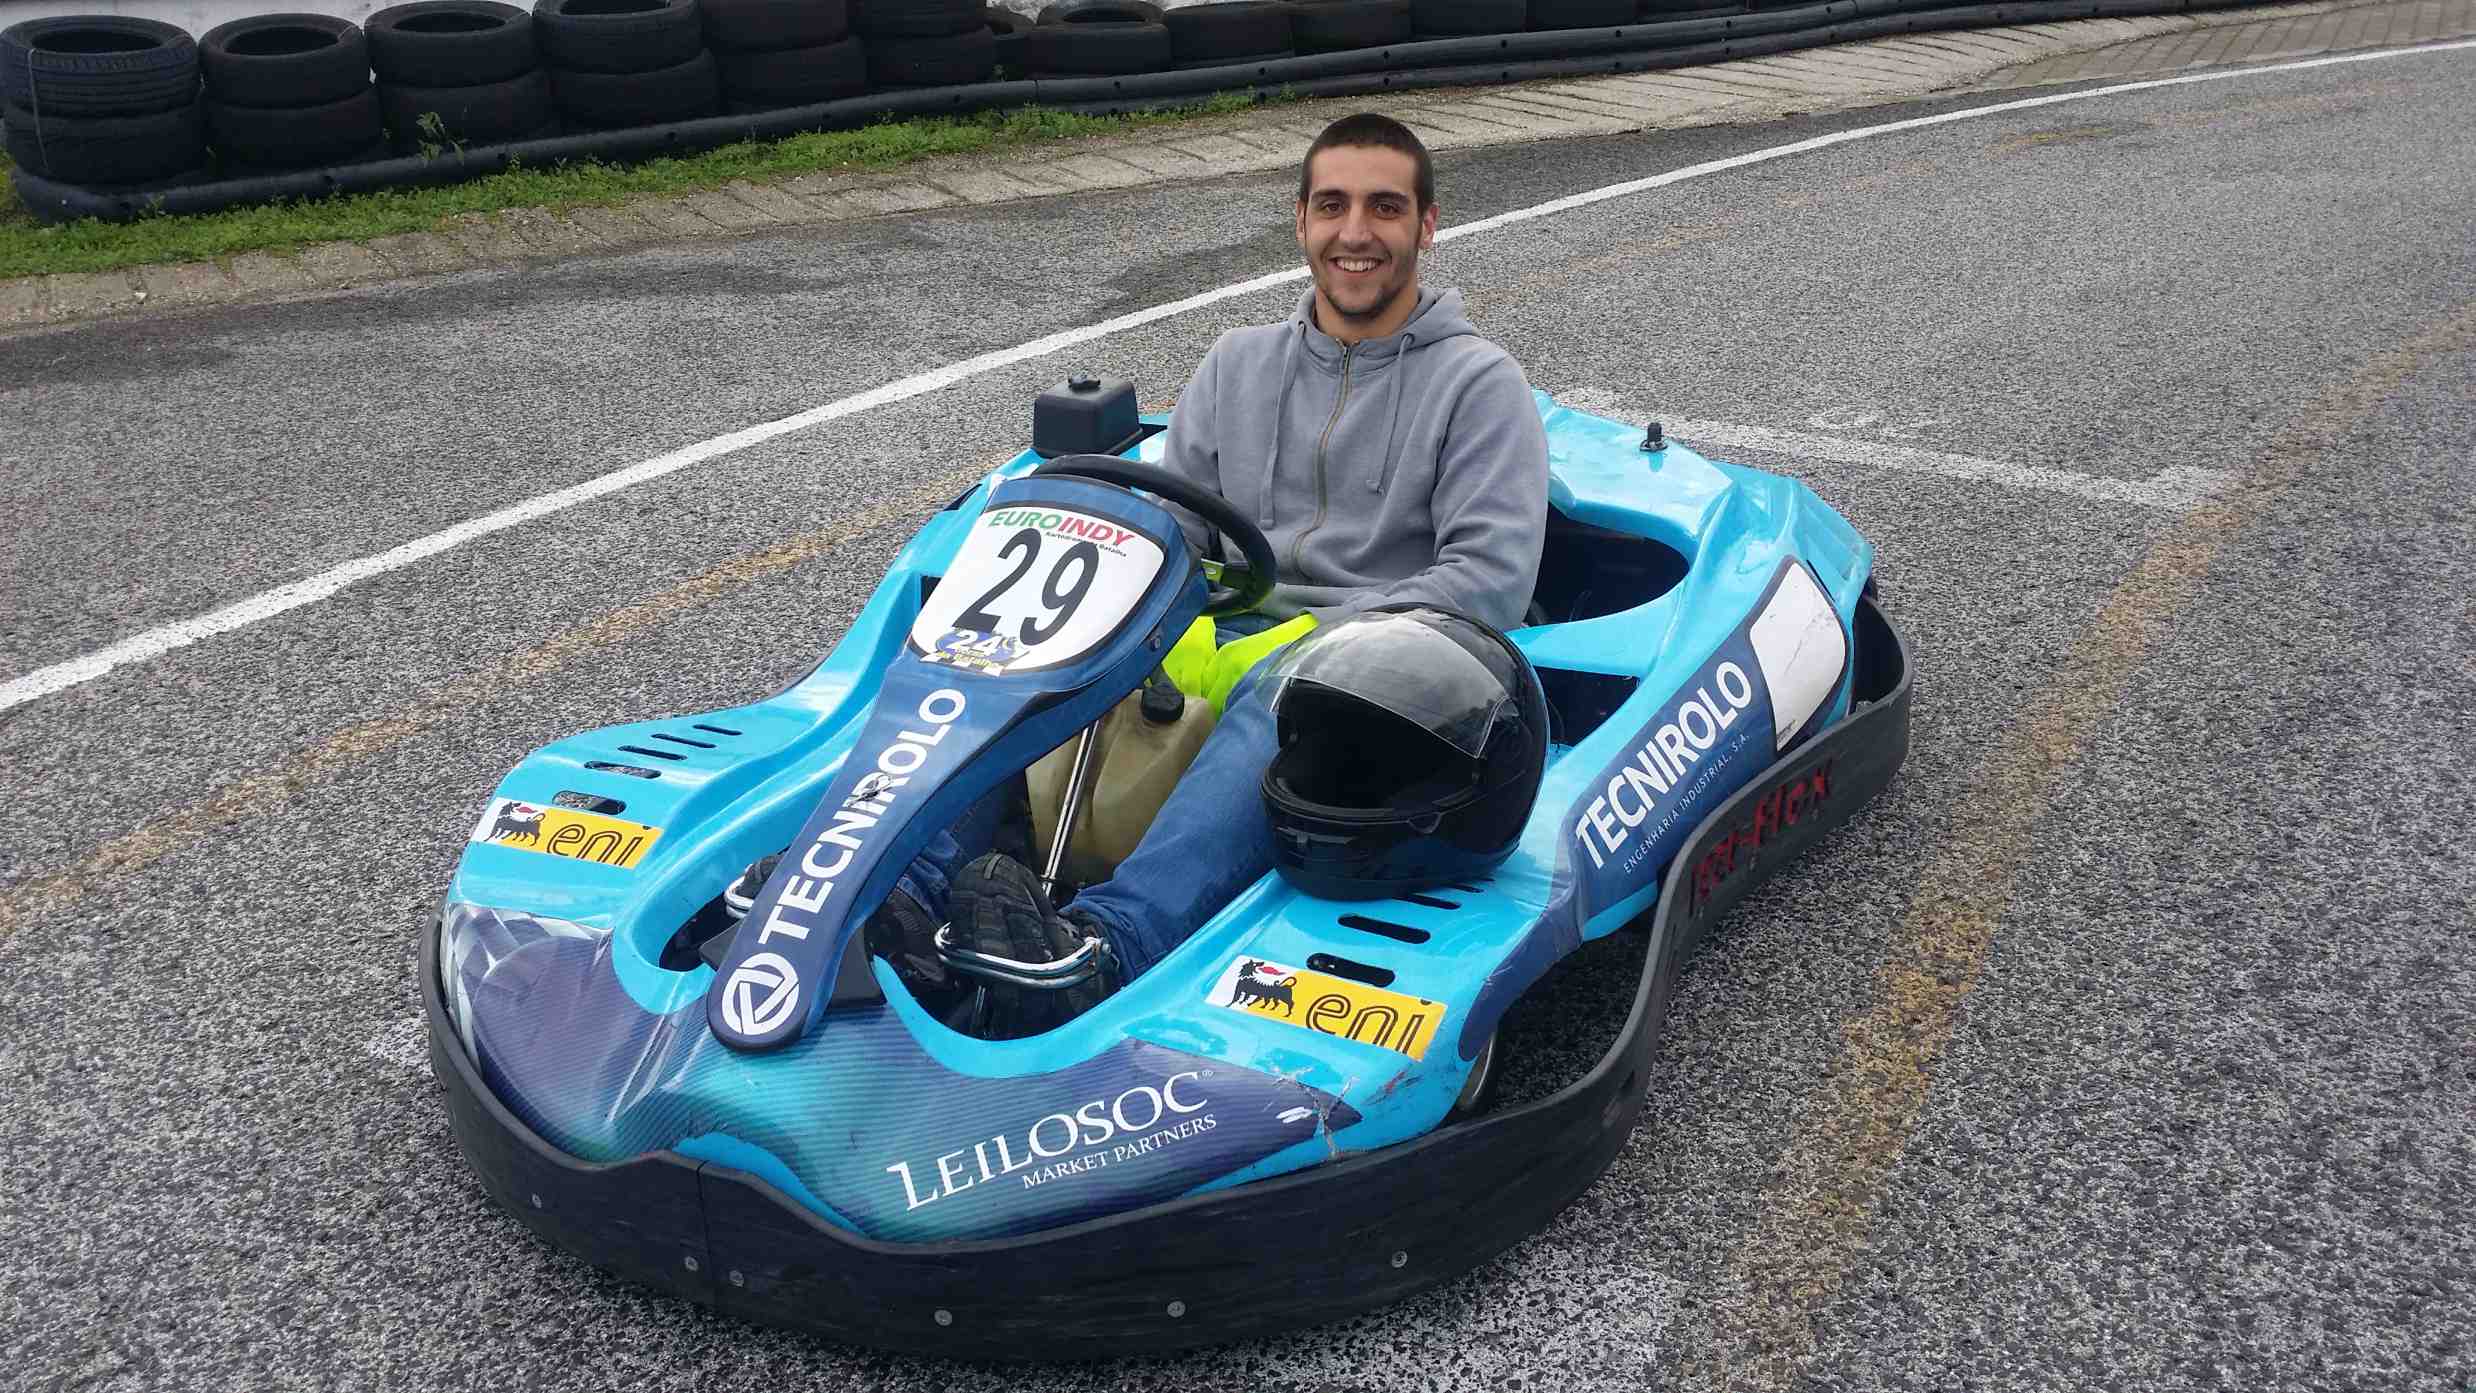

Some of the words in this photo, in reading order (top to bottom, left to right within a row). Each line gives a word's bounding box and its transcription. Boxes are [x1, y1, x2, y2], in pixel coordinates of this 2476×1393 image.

[988, 510, 1134, 545] EUROINDY
[951, 528, 1099, 646] 29
[1575, 661, 1752, 869] TECNIROLO
[546, 823, 650, 866] eni
[758, 689, 966, 945] TECNIROLO
[1623, 808, 1680, 873] ENGENHARIA
[1305, 993, 1433, 1055] eni
[886, 1070, 1208, 1211] LEILOSOC
[1022, 1151, 1109, 1190] MARKET
[1115, 1113, 1217, 1163] PARTNERS
